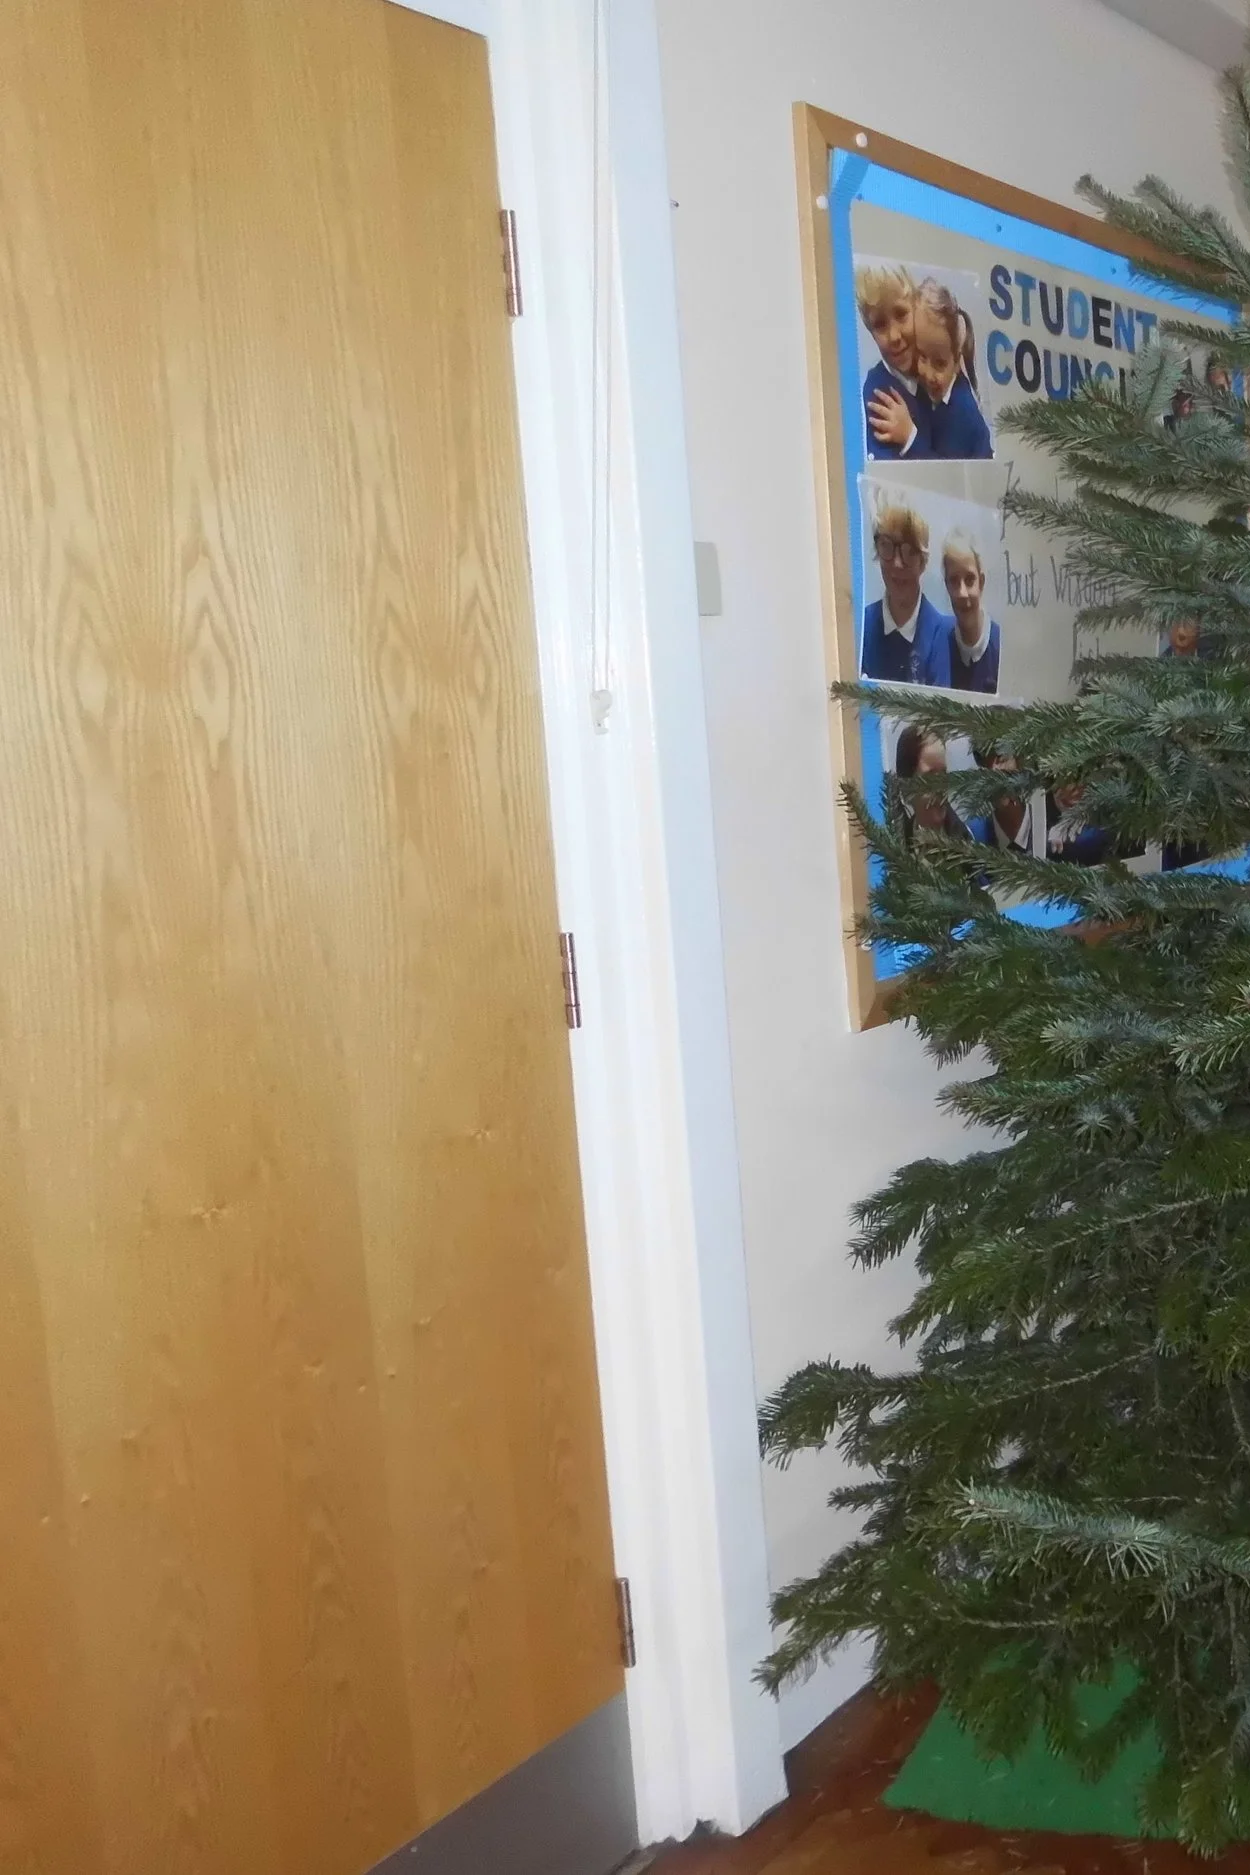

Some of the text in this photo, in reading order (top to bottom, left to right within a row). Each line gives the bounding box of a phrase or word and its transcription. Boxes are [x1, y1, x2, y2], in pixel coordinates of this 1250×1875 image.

[989, 264, 1157, 354] STUDENT
[987, 330, 1137, 404] COUNI
[1004, 550, 1041, 608] but
